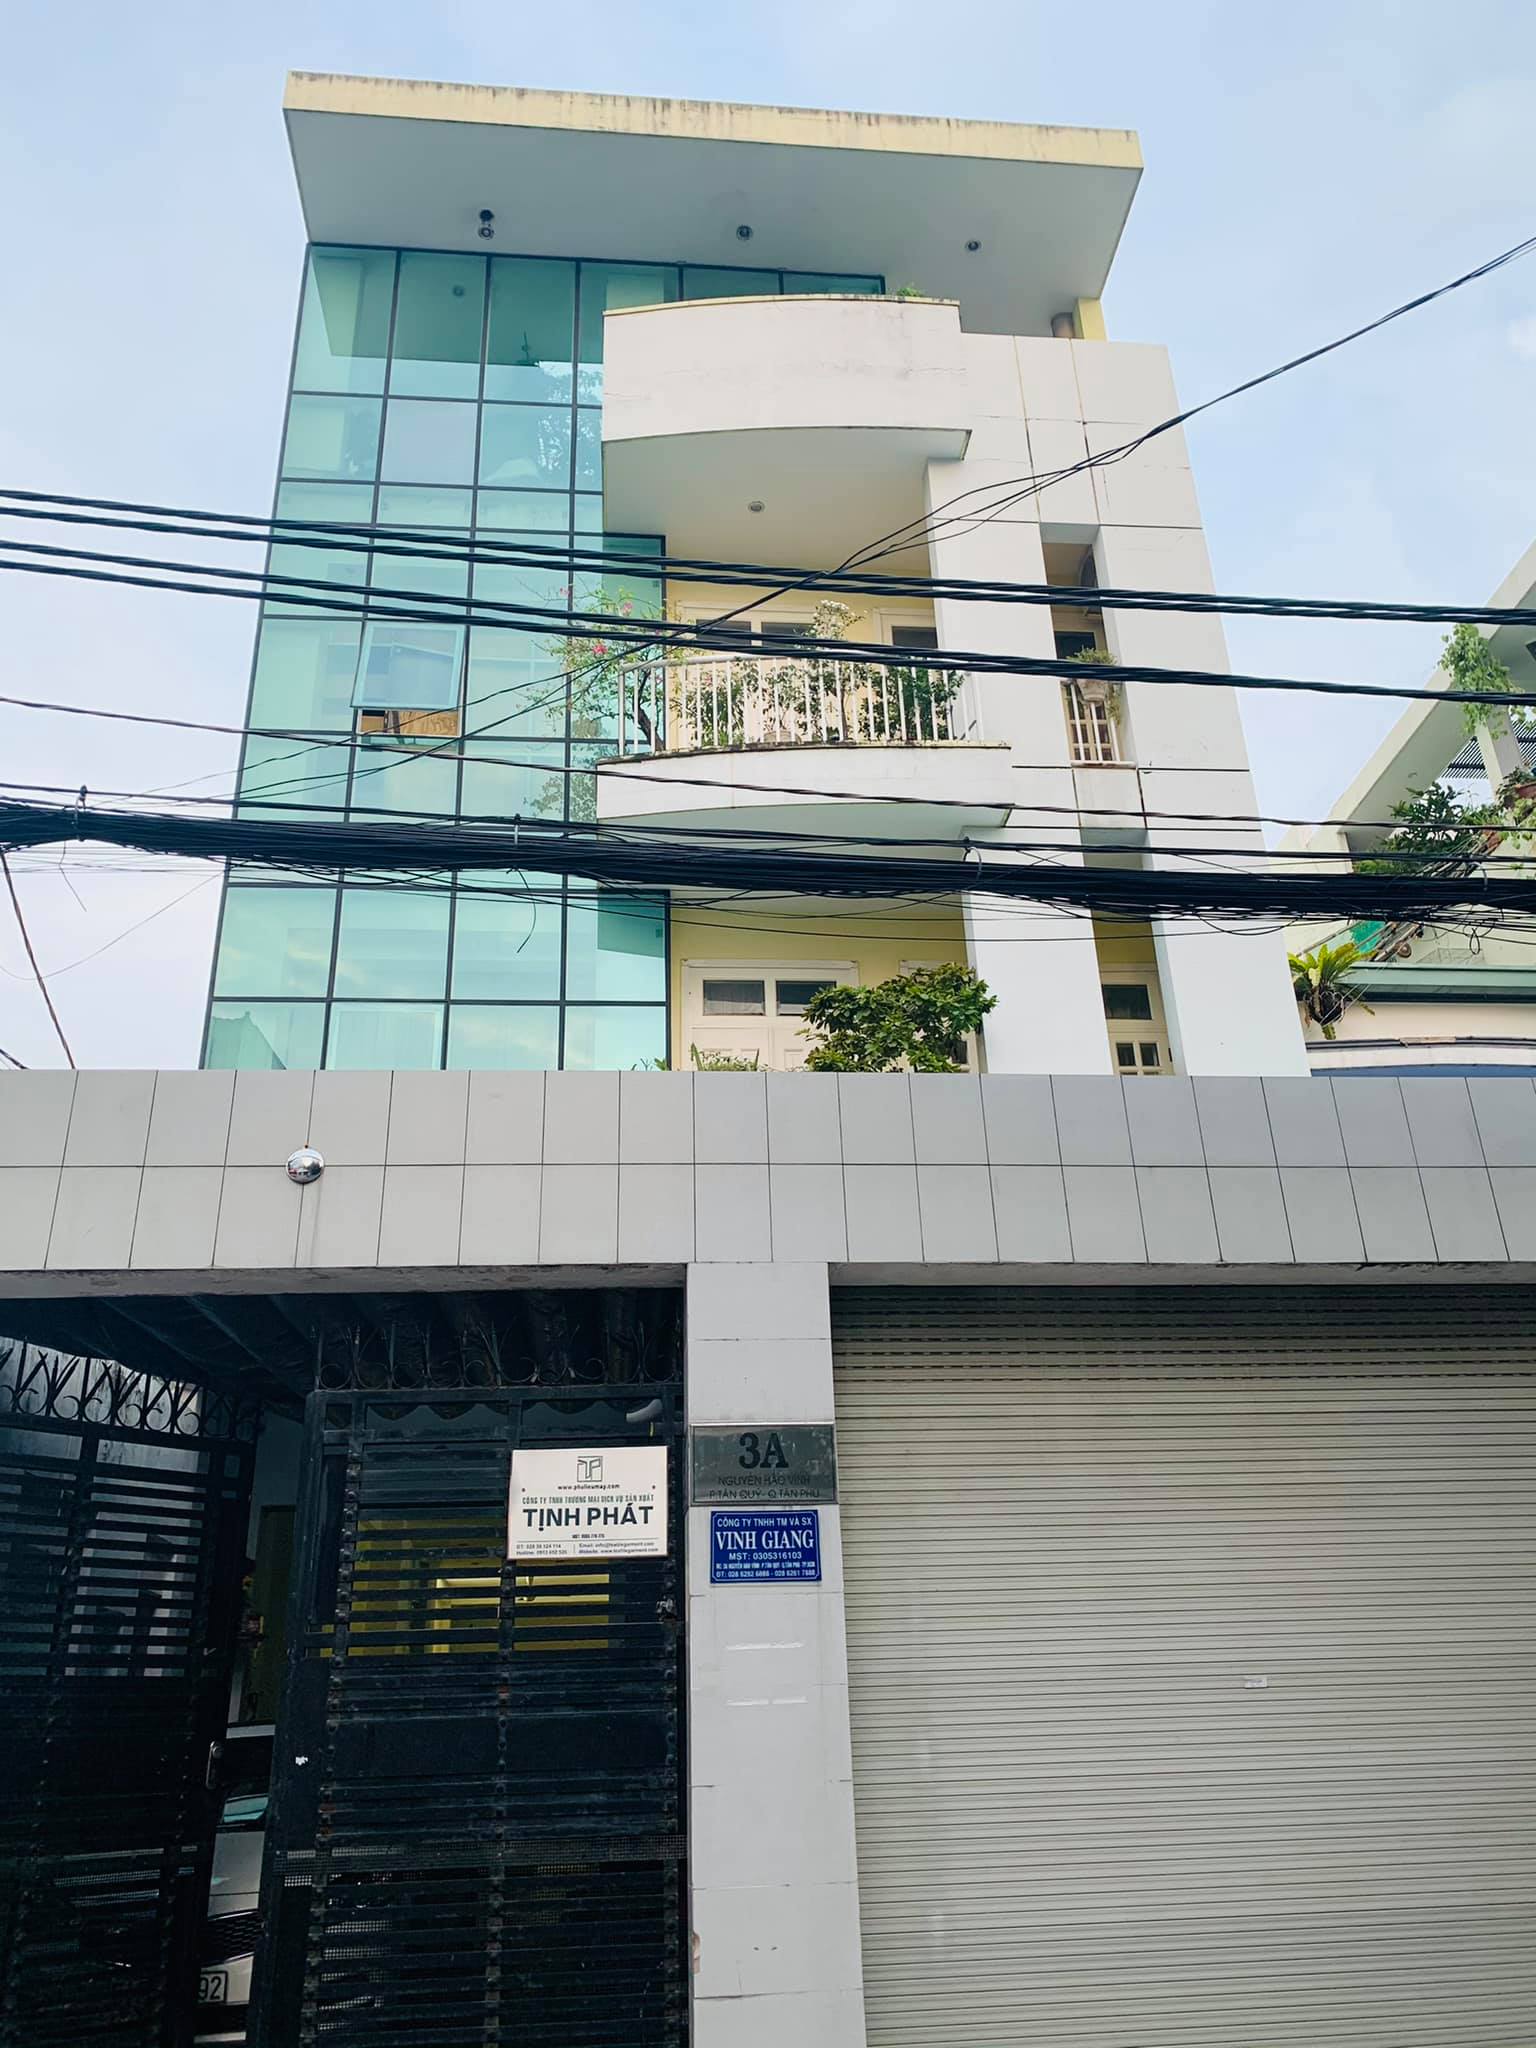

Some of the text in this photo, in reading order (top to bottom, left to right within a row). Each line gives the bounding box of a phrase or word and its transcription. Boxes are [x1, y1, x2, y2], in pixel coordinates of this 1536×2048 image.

[739, 1432, 789, 1469] 3A
[522, 1503, 654, 1531] TỊNH PHÁT
[717, 1517, 740, 1528] CÔNG
[742, 1518, 752, 1527] TY
[754, 1518, 775, 1526] TNHH
[777, 1517, 788, 1526] TM
[801, 1516, 812, 1526] SX
[716, 1529, 814, 1550] VINH GIANG
[729, 1551, 802, 1561] MST: 0305316103
